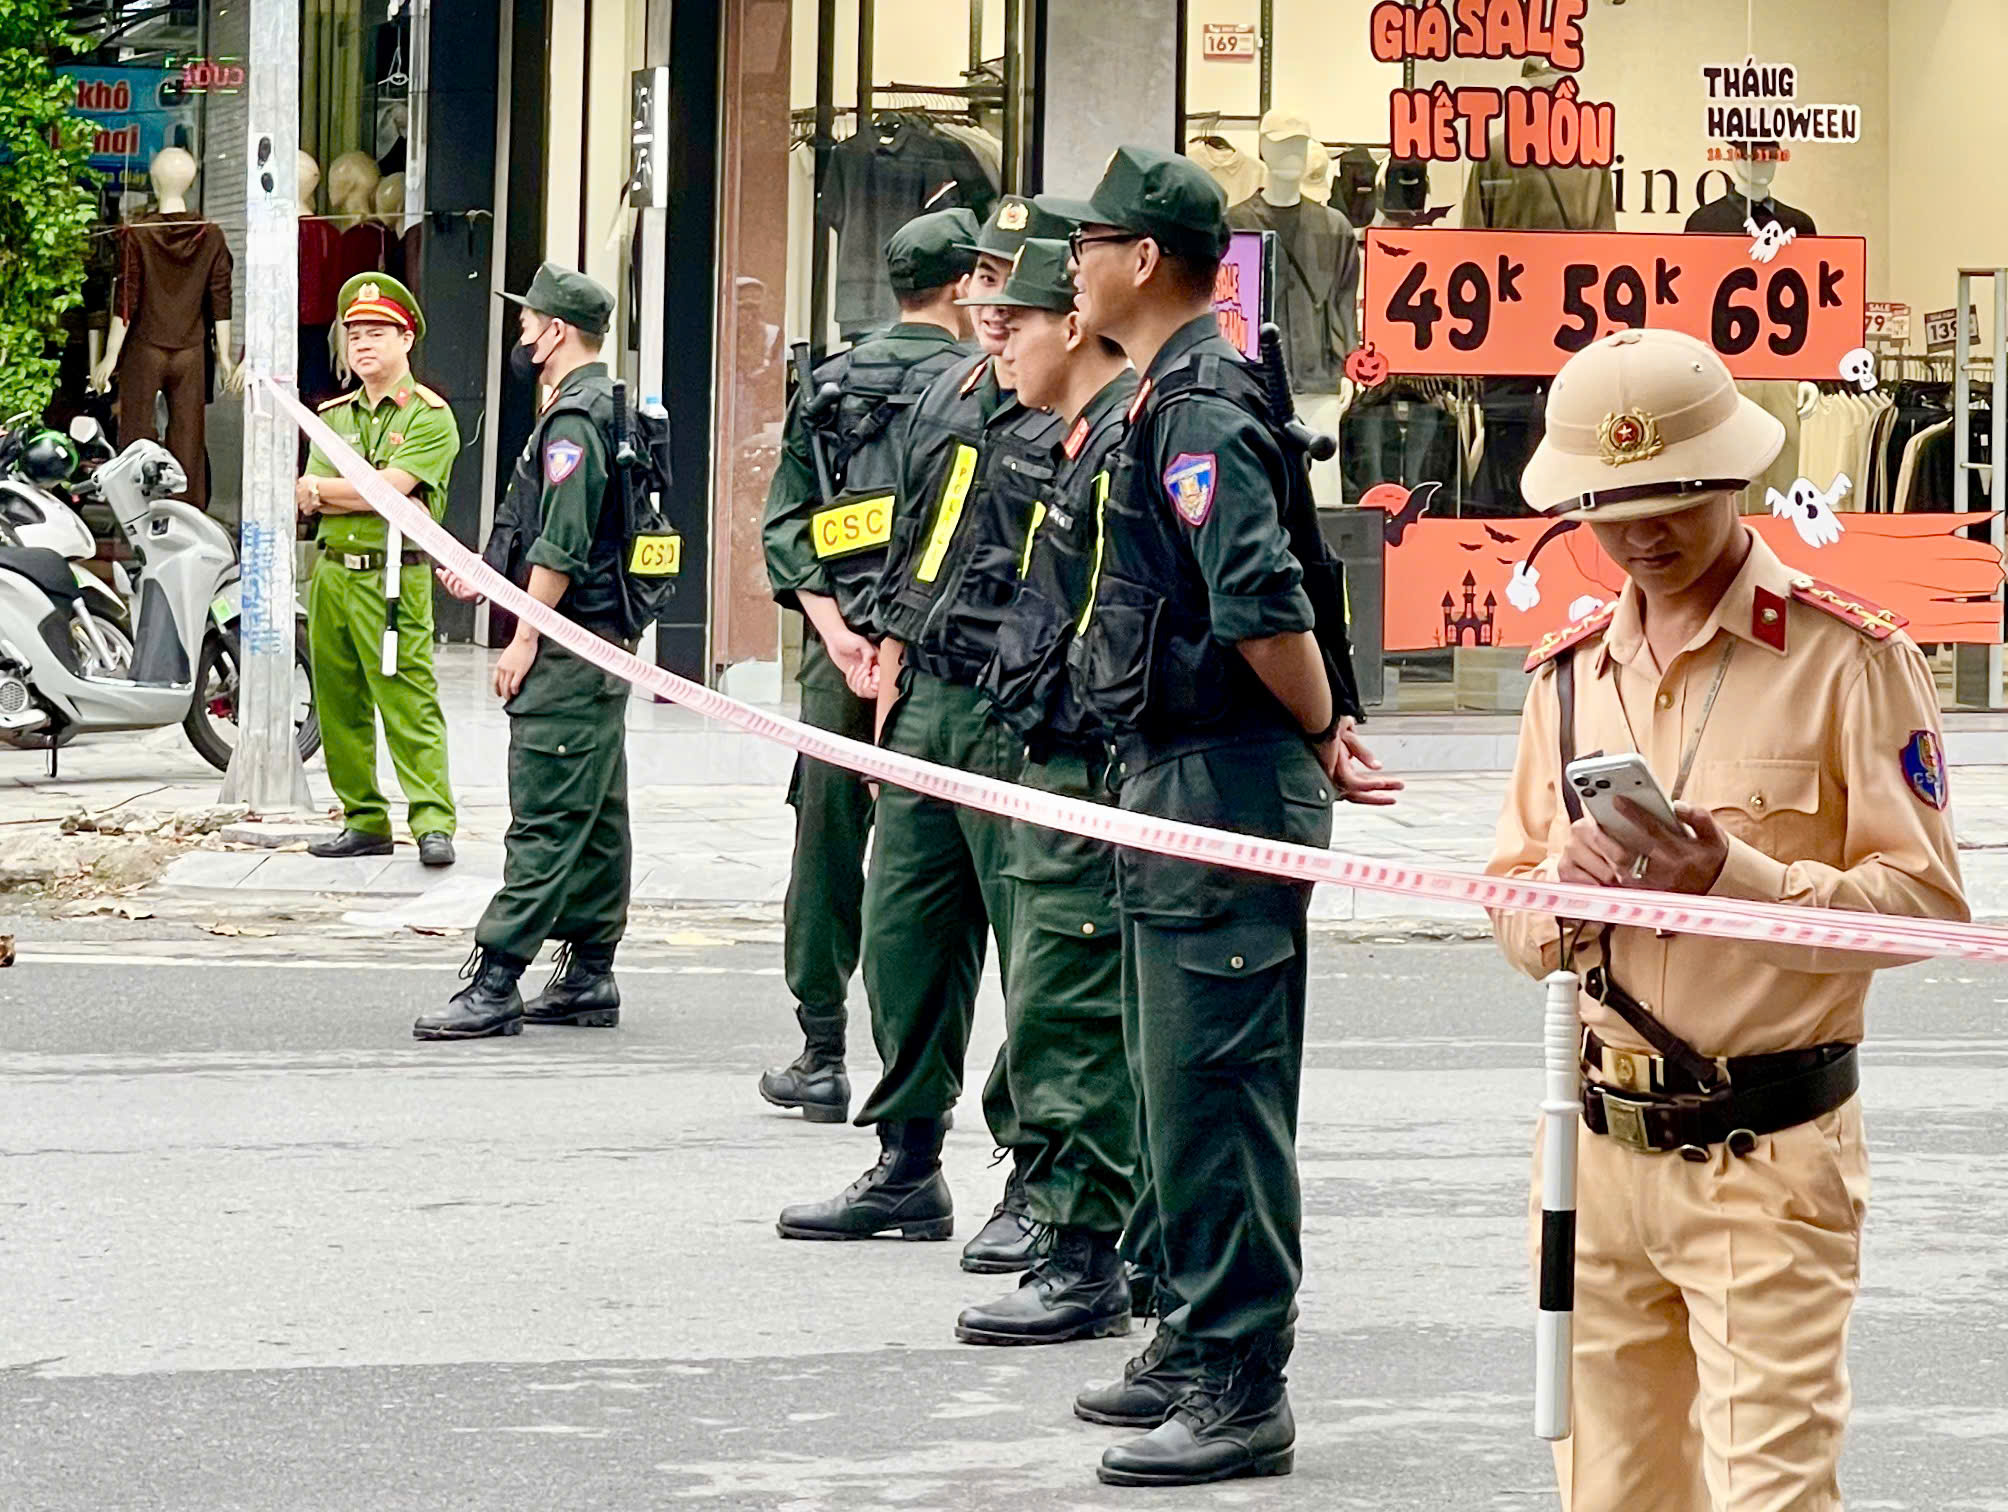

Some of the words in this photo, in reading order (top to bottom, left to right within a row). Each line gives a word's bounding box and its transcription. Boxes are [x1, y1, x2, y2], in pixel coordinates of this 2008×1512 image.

[1208, 36, 1238, 52] 169
[1453, 0, 1587, 72] SALE
[77, 80, 130, 110] khô
[1703, 58, 1794, 97] THÁNG
[1390, 80, 1502, 162] HẾT
[1505, 76, 1616, 168] HỒN
[1708, 107, 1857, 139] HALLOWEEN
[822, 508, 884, 547] CSC
